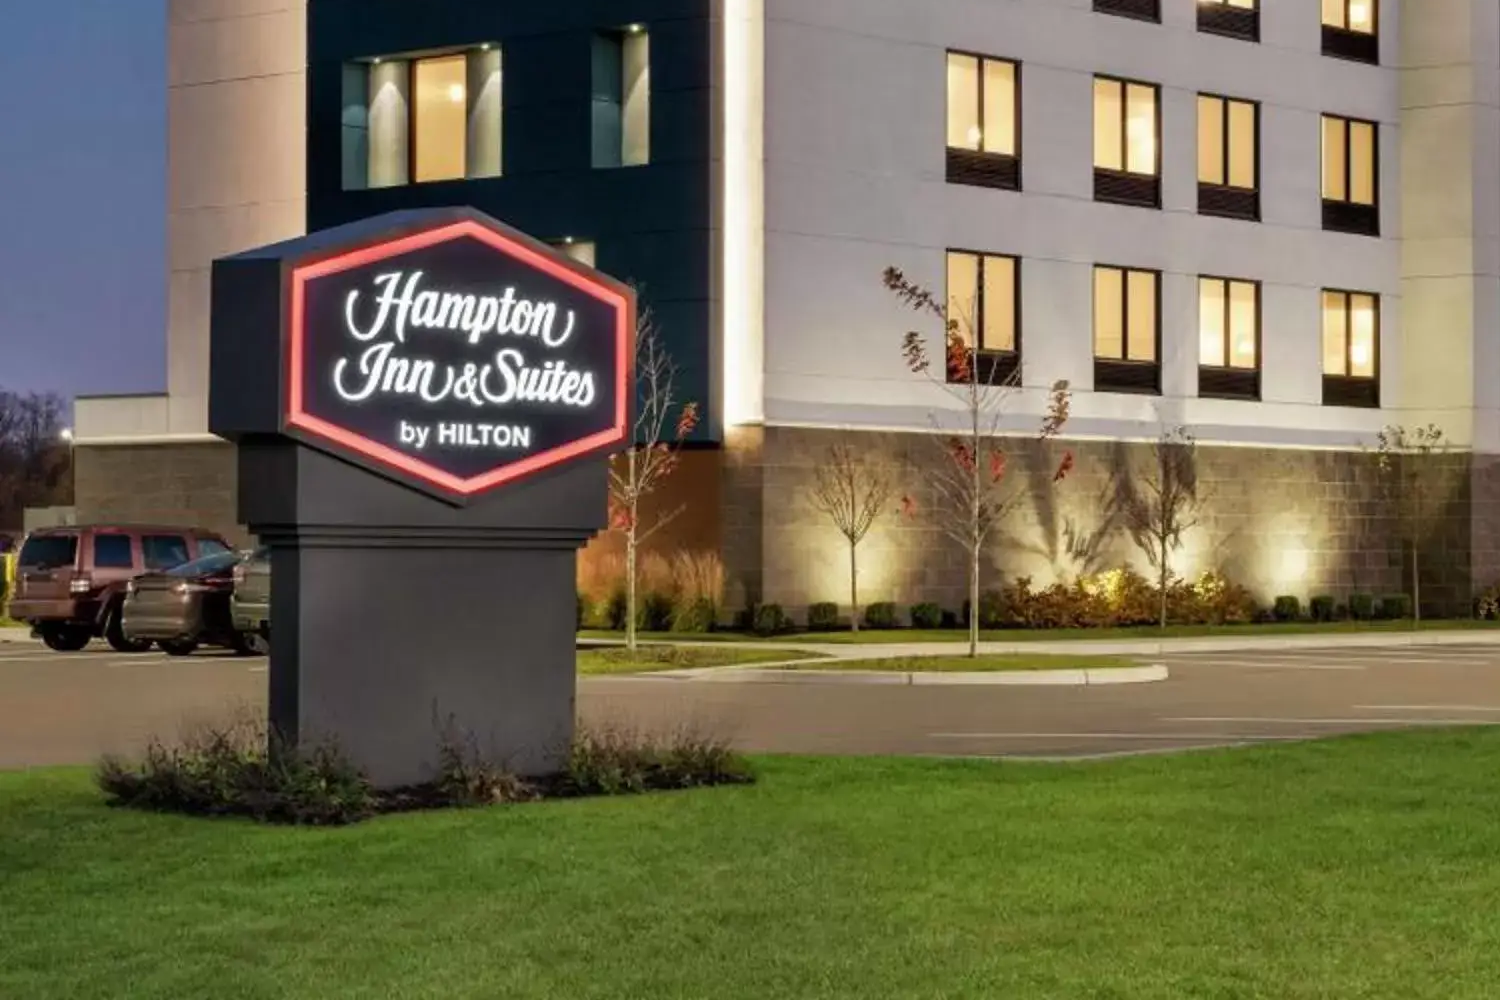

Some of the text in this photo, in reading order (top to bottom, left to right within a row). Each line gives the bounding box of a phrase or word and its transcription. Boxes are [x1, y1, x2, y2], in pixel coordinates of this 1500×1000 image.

[345, 271, 575, 348] Hampton
[401, 422, 531, 449] by HILTON
